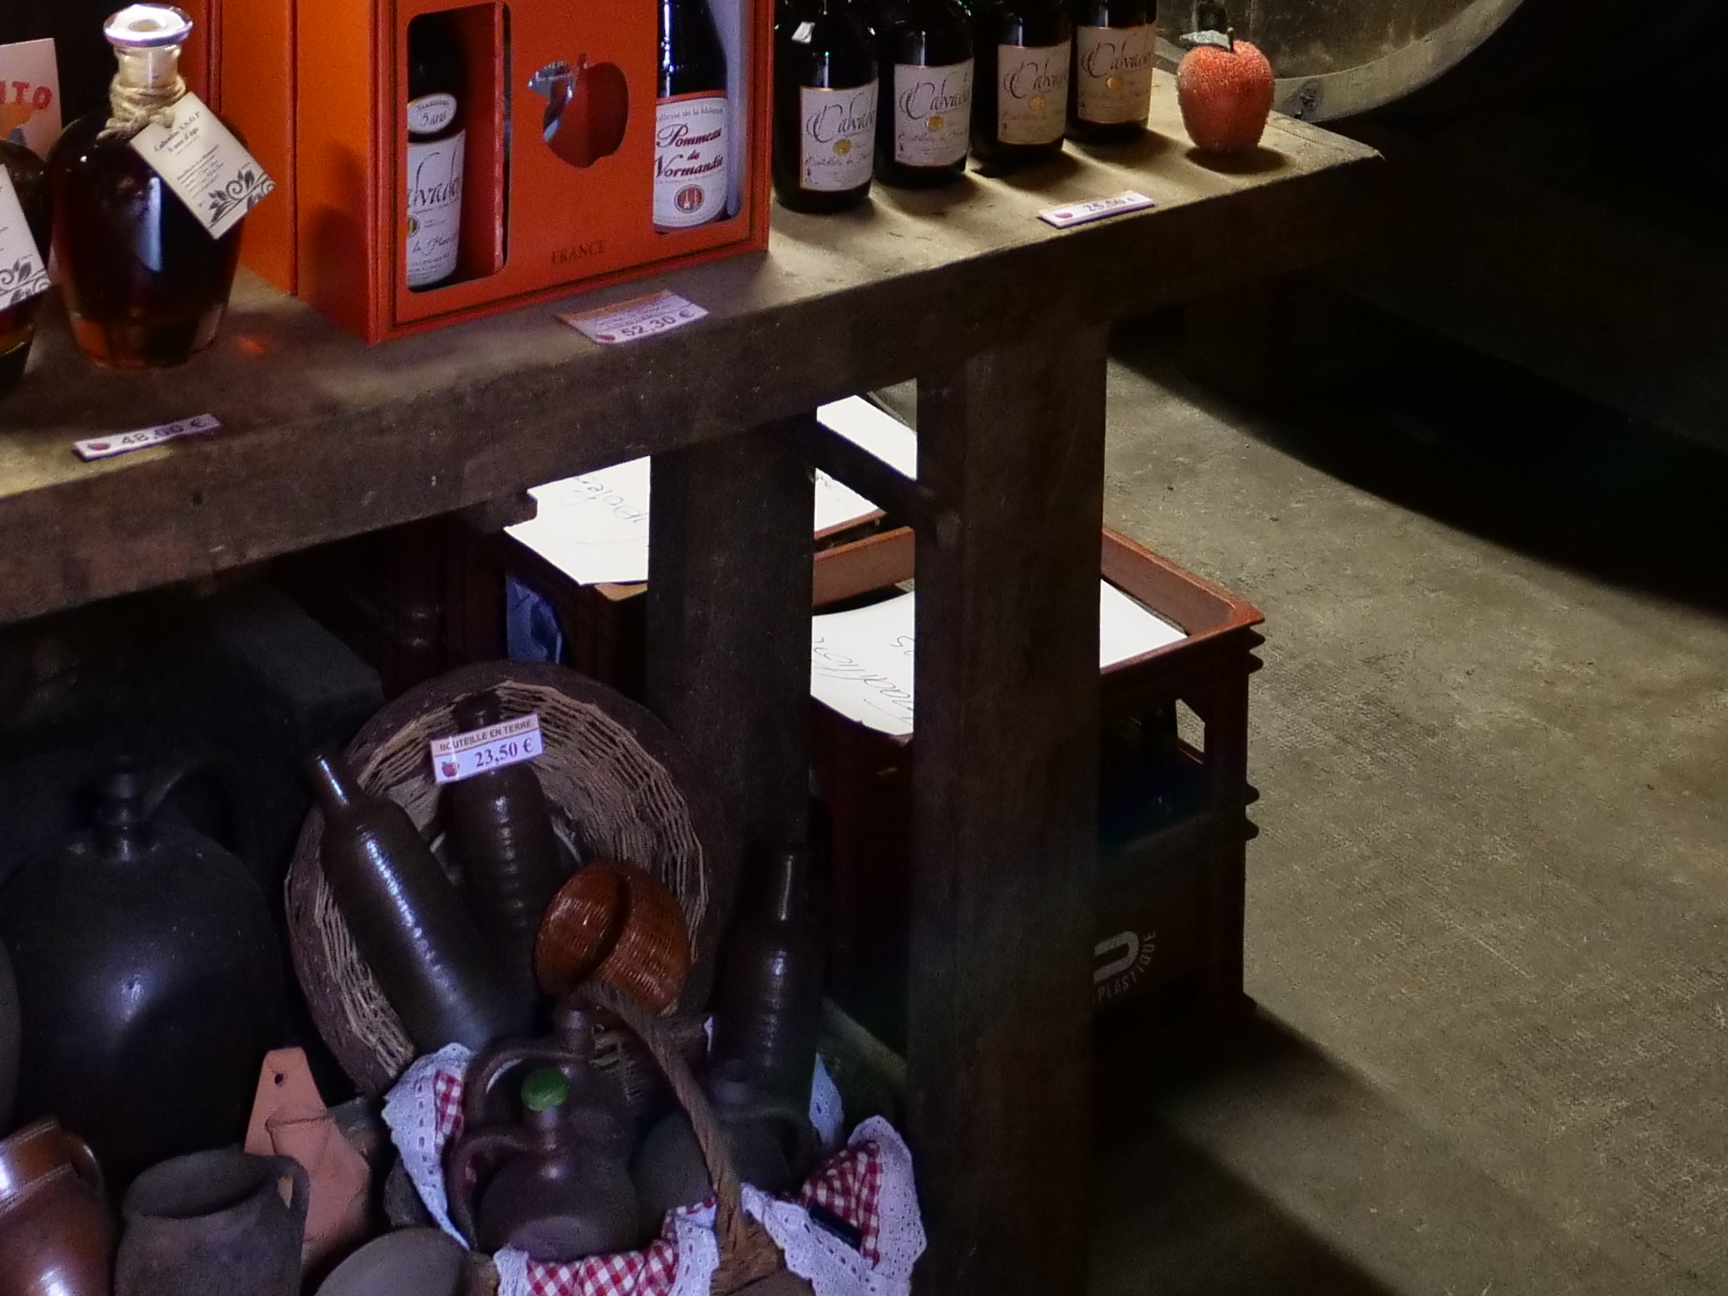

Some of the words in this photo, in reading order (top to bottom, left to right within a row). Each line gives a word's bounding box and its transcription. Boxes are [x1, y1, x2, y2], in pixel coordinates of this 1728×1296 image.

[550, 239, 606, 264] FRANCE
[622, 314, 676, 337] 52,30
[439, 730, 488, 751] BOUTEILLE
[489, 728, 502, 739] EN
[502, 718, 533, 734] TERRE
[474, 740, 518, 768] 23,50
[522, 736, 534, 754] €
